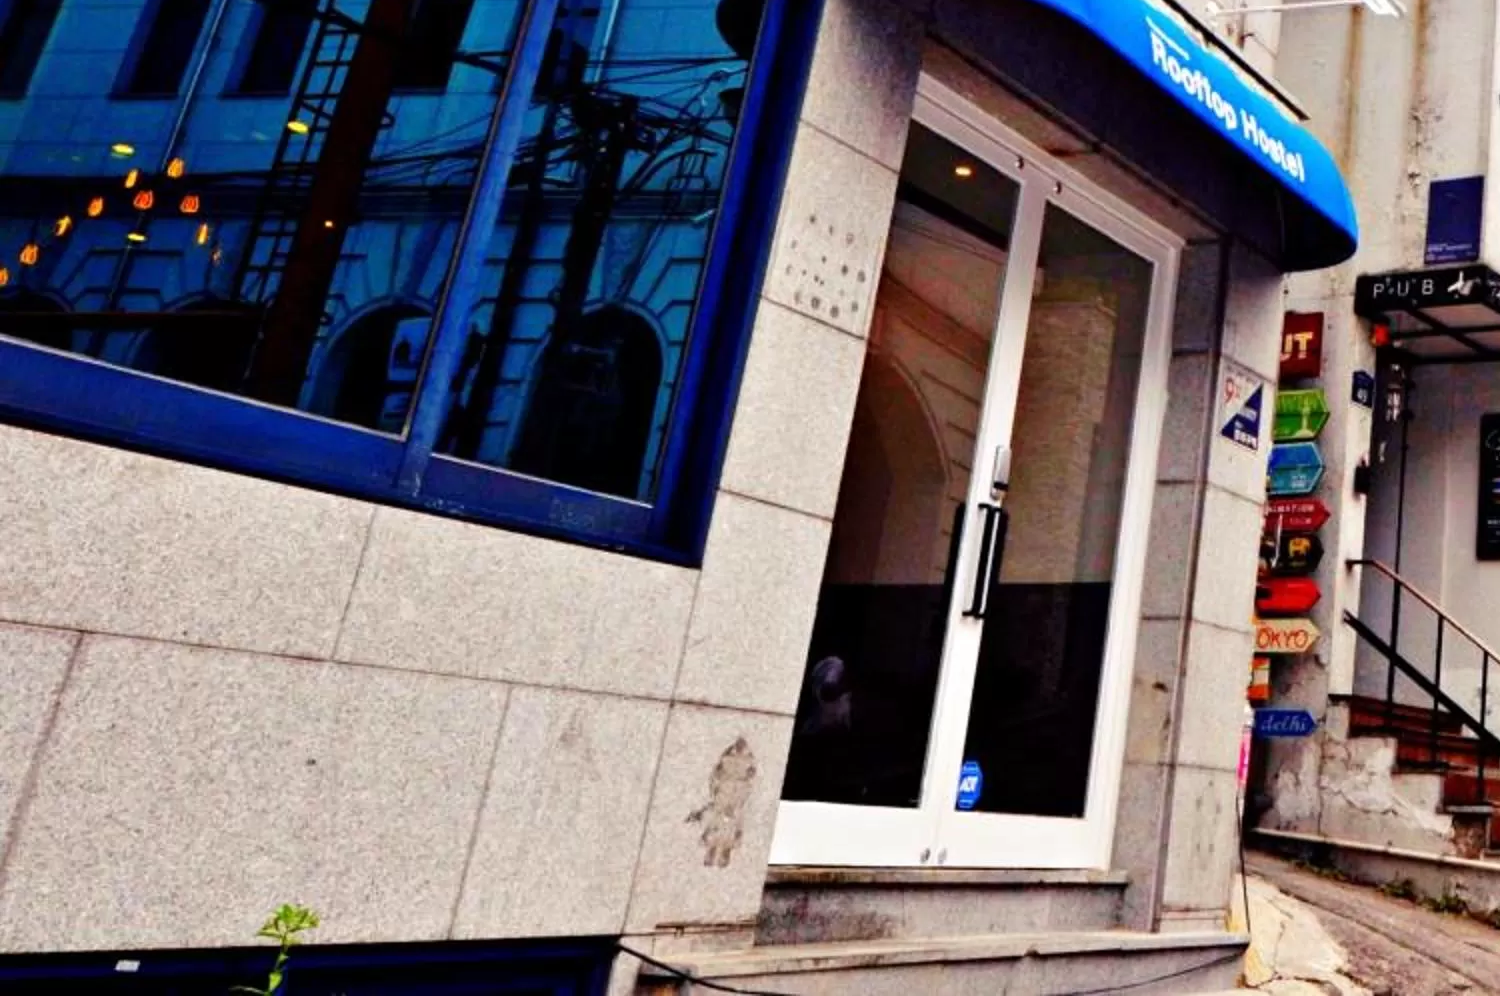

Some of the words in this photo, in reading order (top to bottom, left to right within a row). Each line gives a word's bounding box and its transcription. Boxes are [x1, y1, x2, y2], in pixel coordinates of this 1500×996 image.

[1151, 30, 1238, 130] Rooftop
[1240, 108, 1305, 182] Hostel
[1256, 624, 1310, 649] OKYO
[1261, 711, 1308, 732] delhi
